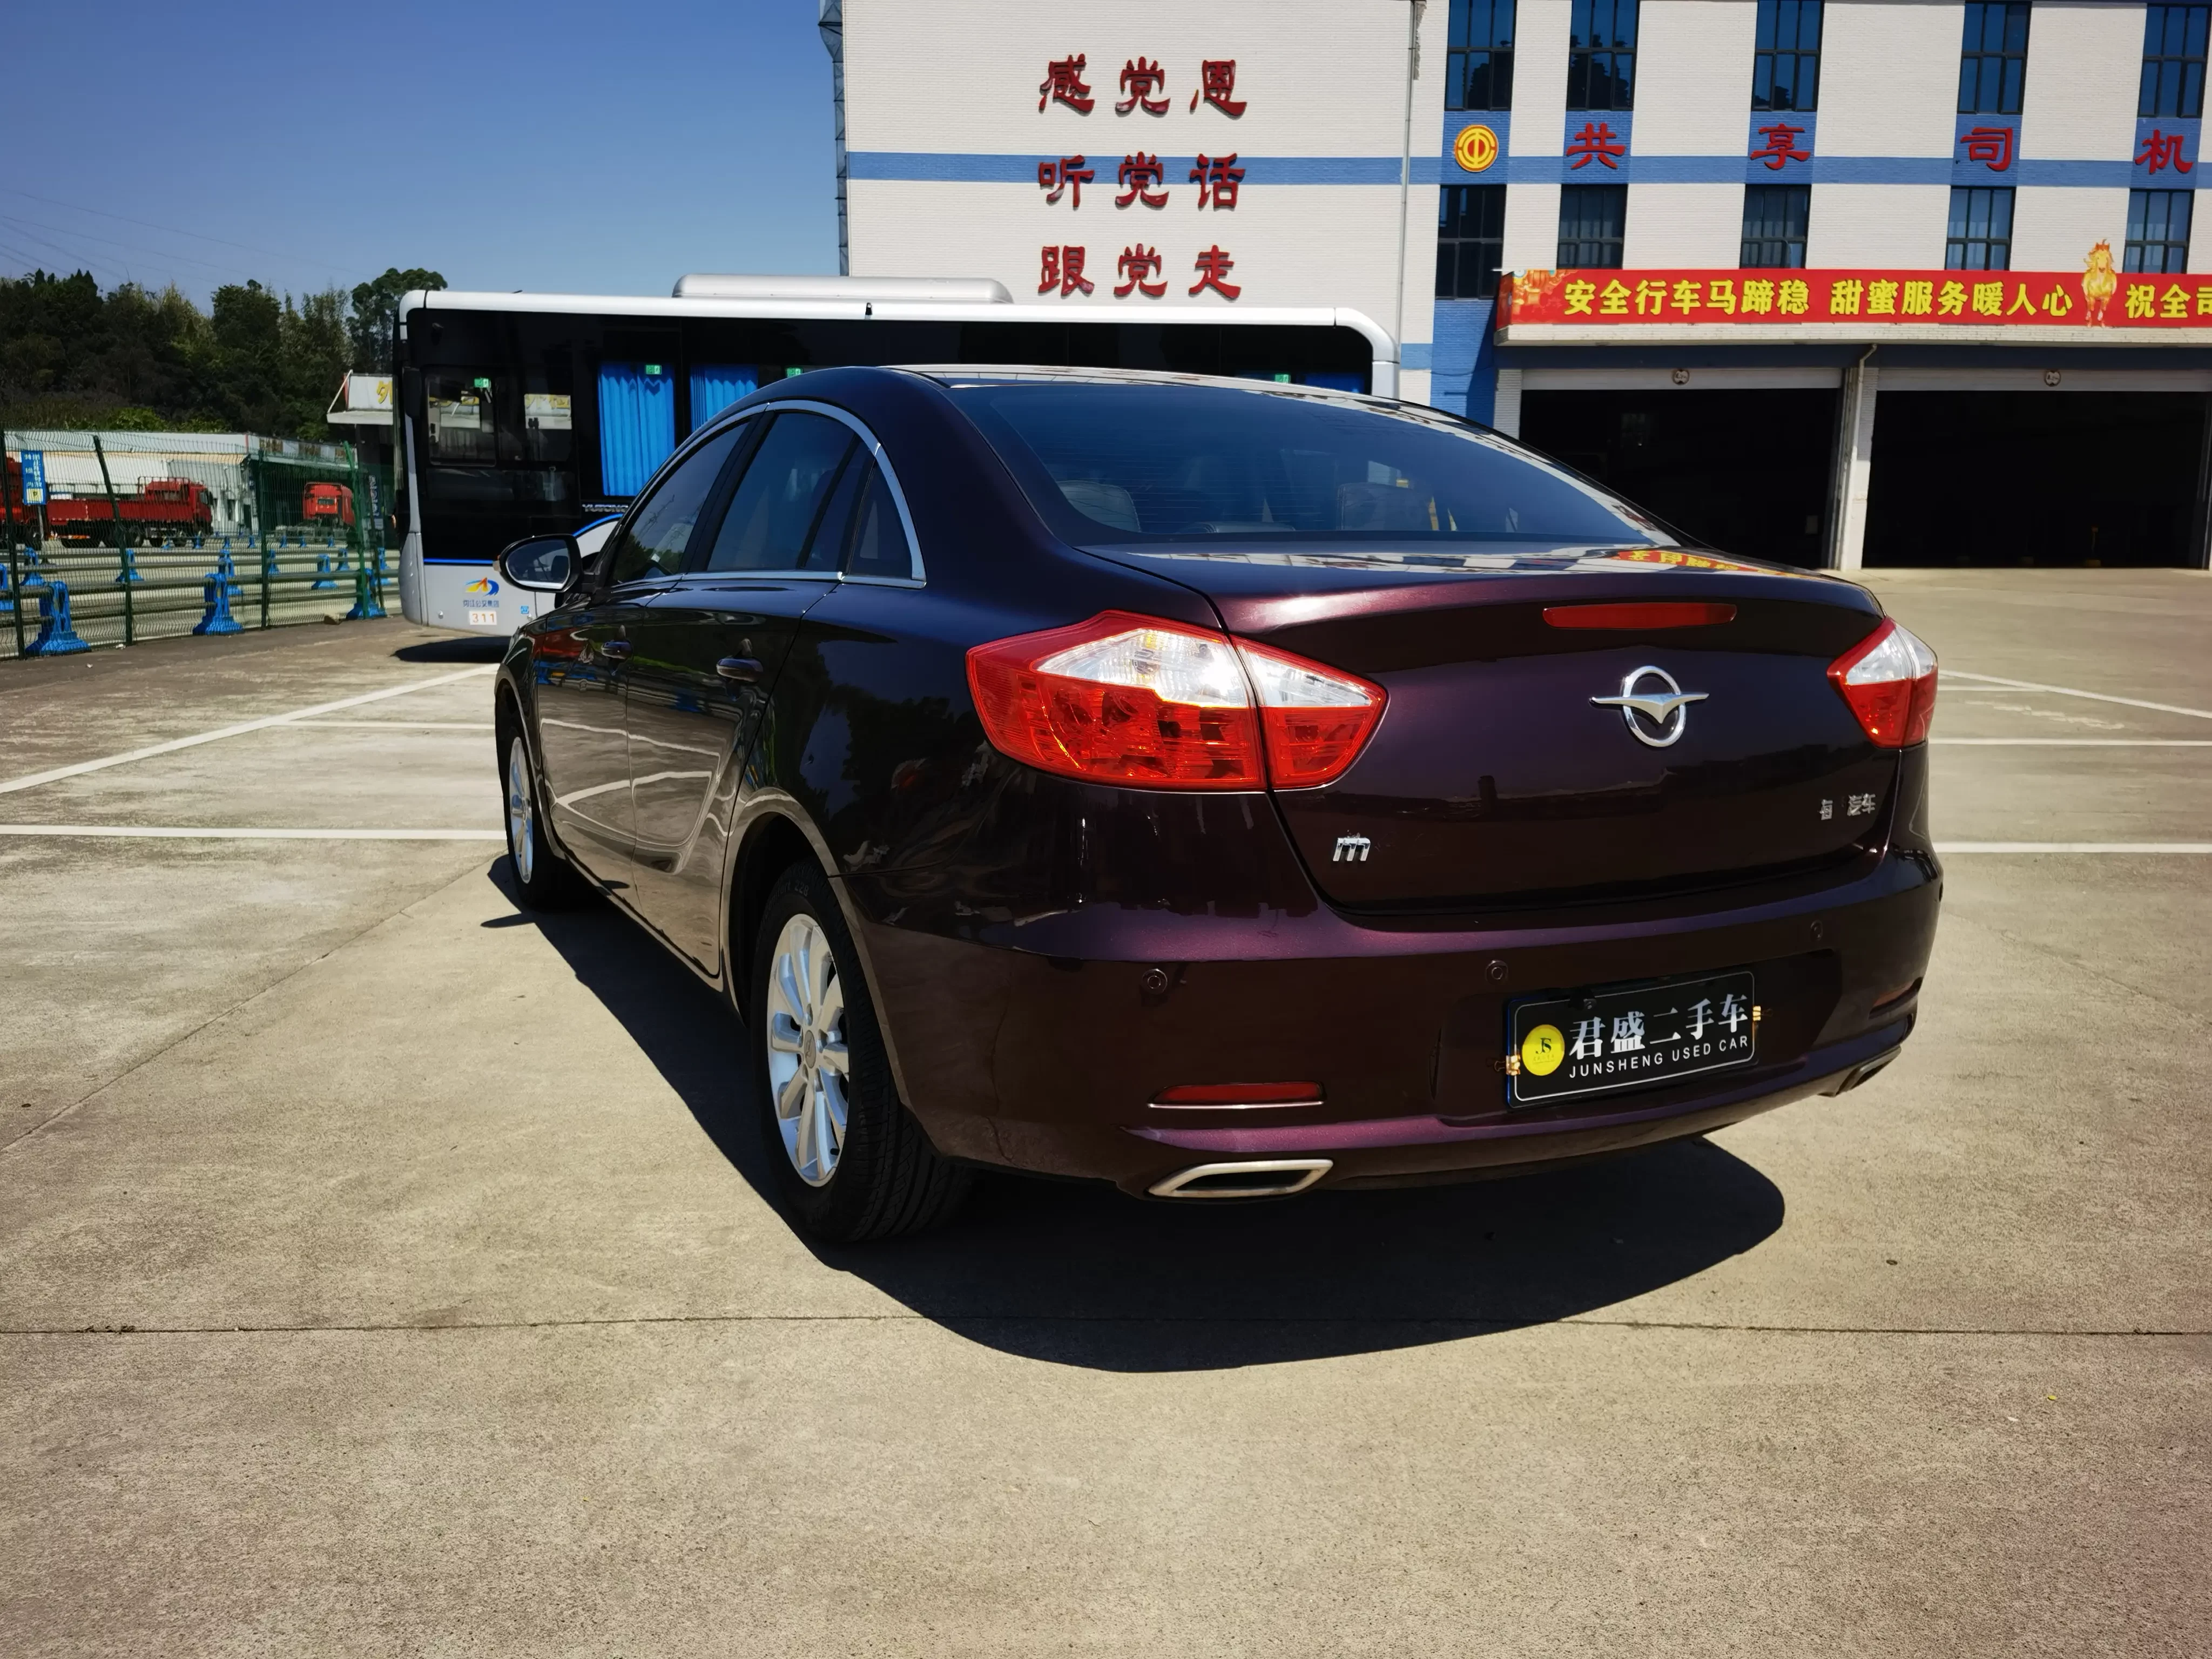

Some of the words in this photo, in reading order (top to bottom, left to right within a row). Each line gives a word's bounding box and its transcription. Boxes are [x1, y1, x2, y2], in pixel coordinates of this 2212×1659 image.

[1038, 53, 1247, 117] 感党恩
[1038, 152, 1245, 210] 听党话
[1037, 243, 1241, 300] 跟党走
[1564, 279, 1809, 315] 安全行车马蹄稳
[1830, 279, 2073, 317] 甜蜜服务暖人心
[471, 613, 495, 623] 311
[1569, 994, 1749, 1060] 君盛二手车
[1569, 1053, 1663, 1078] JUNSHENG
[1672, 1043, 1711, 1061] USED
[1719, 1035, 1748, 1052] CAR
